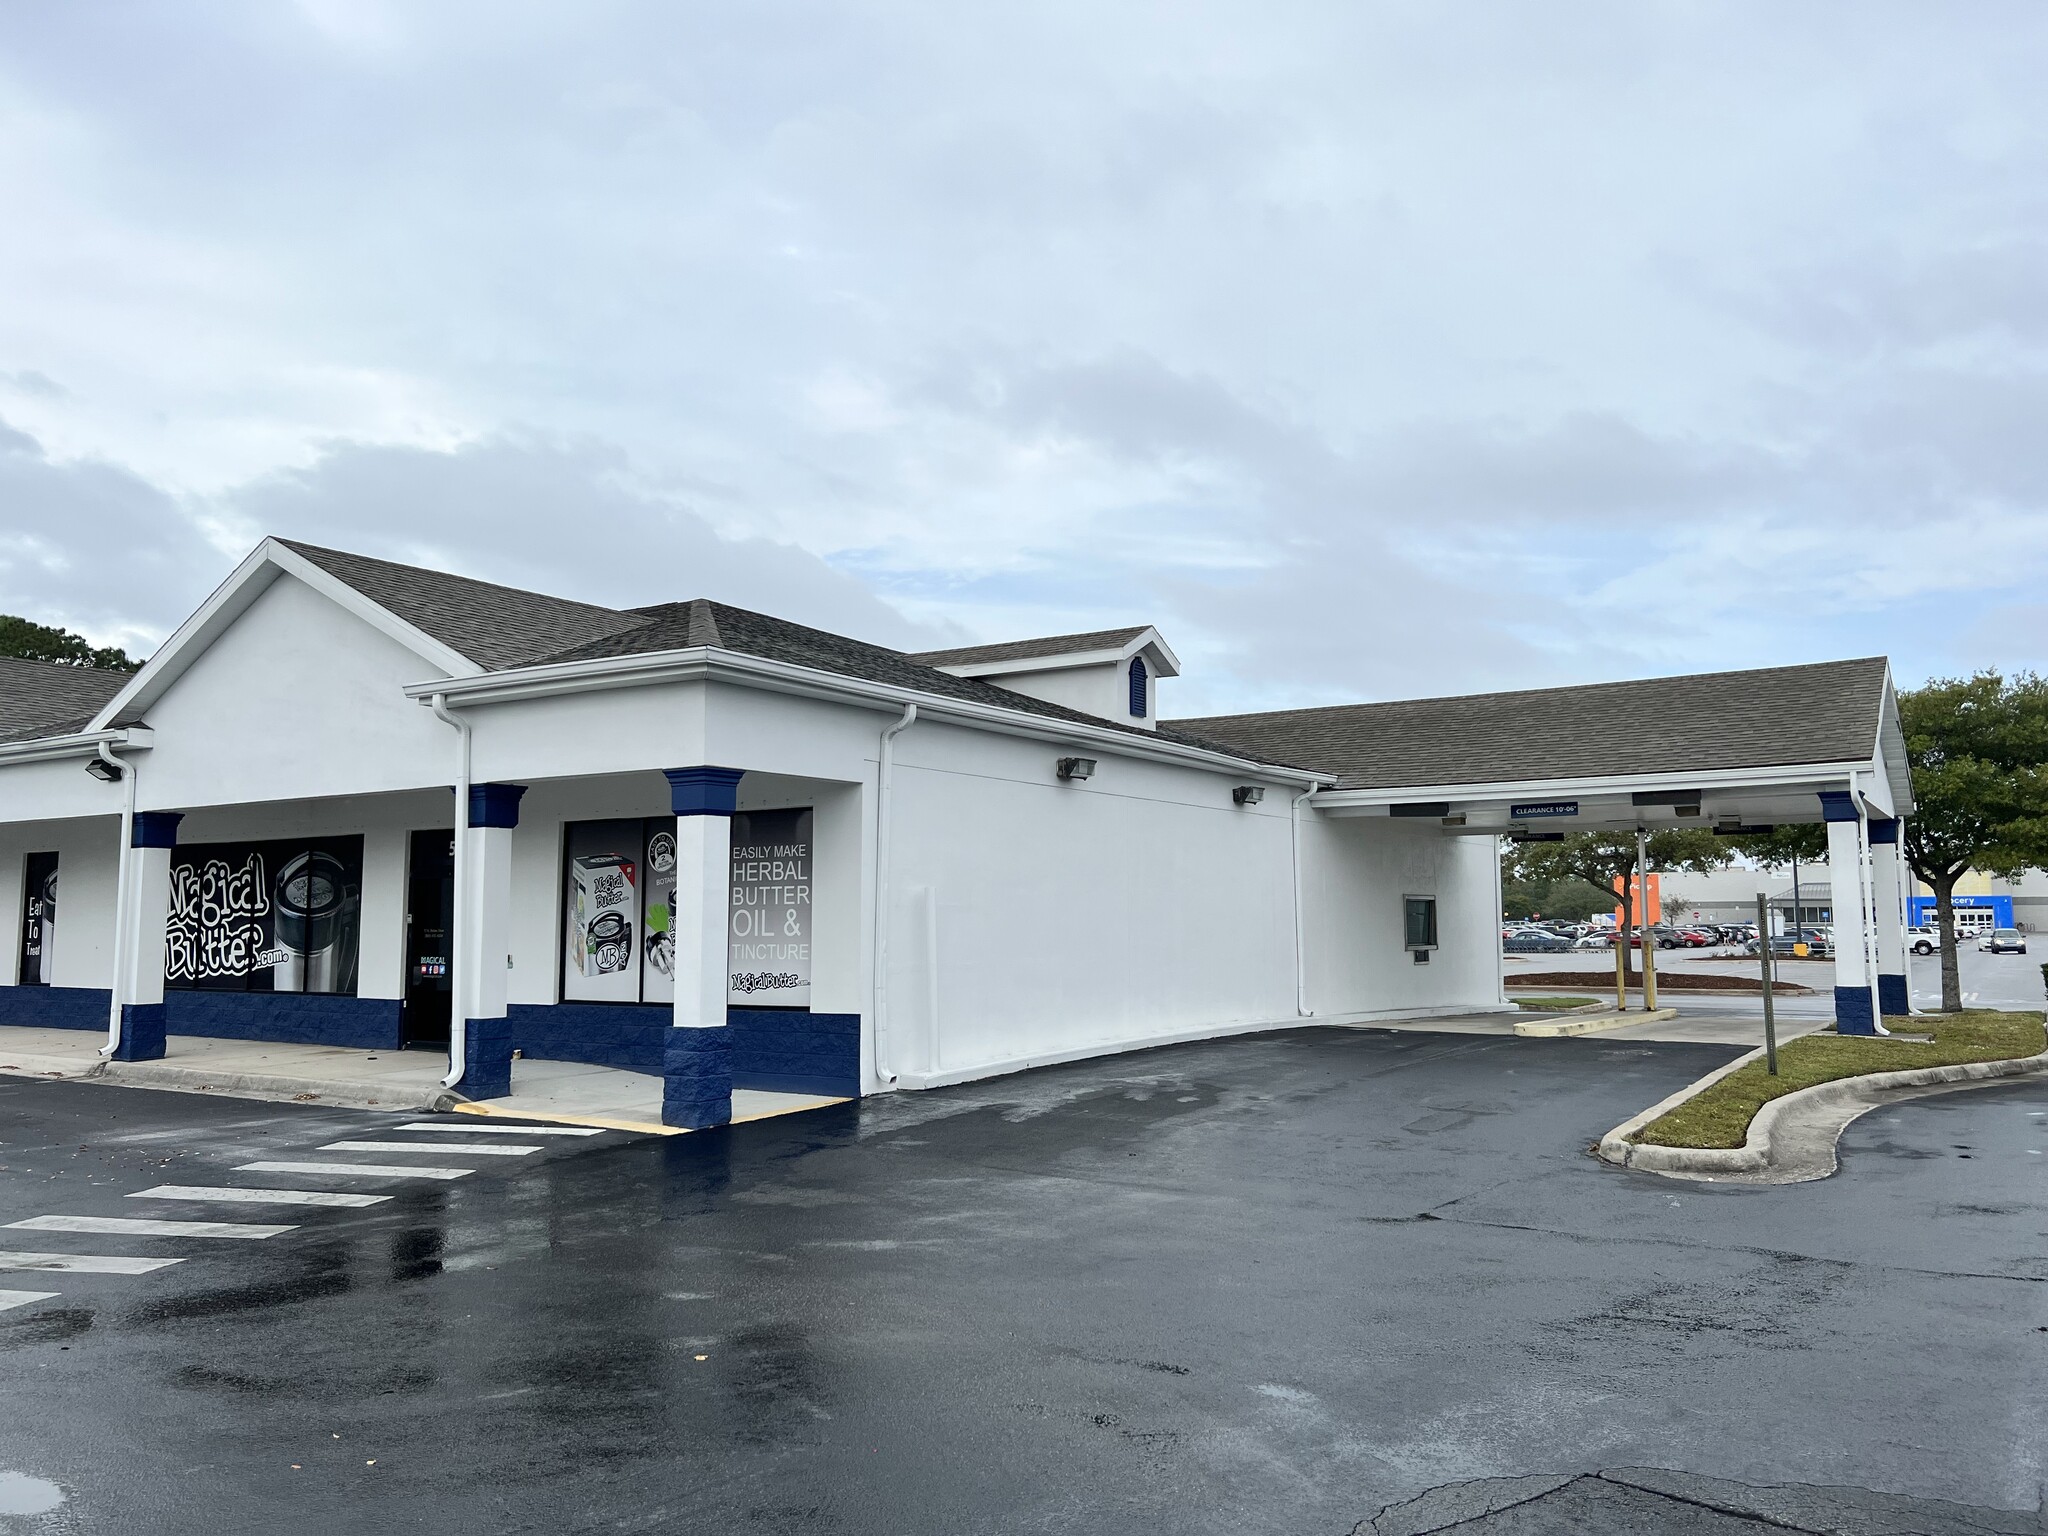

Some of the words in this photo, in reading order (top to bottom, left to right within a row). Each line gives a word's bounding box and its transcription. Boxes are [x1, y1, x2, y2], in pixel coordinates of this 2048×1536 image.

[1516, 807, 1554, 815] CLEARANCE
[733, 846, 771, 859] EASILY
[774, 844, 807, 858] MAKE
[733, 860, 808, 882] HERBAL
[594, 872, 624, 894] Magical
[1629, 883, 1652, 891] Picp
[732, 885, 810, 906] BUTTER
[28, 896, 43, 917] Eat
[28, 919, 39, 939] To
[732, 909, 775, 937] OIL
[783, 908, 801, 937] &
[26, 942, 41, 956] Treat
[600, 947, 617, 966] MB
[732, 943, 809, 960] TINCTURE
[420, 956, 446, 965] MAGICAL
